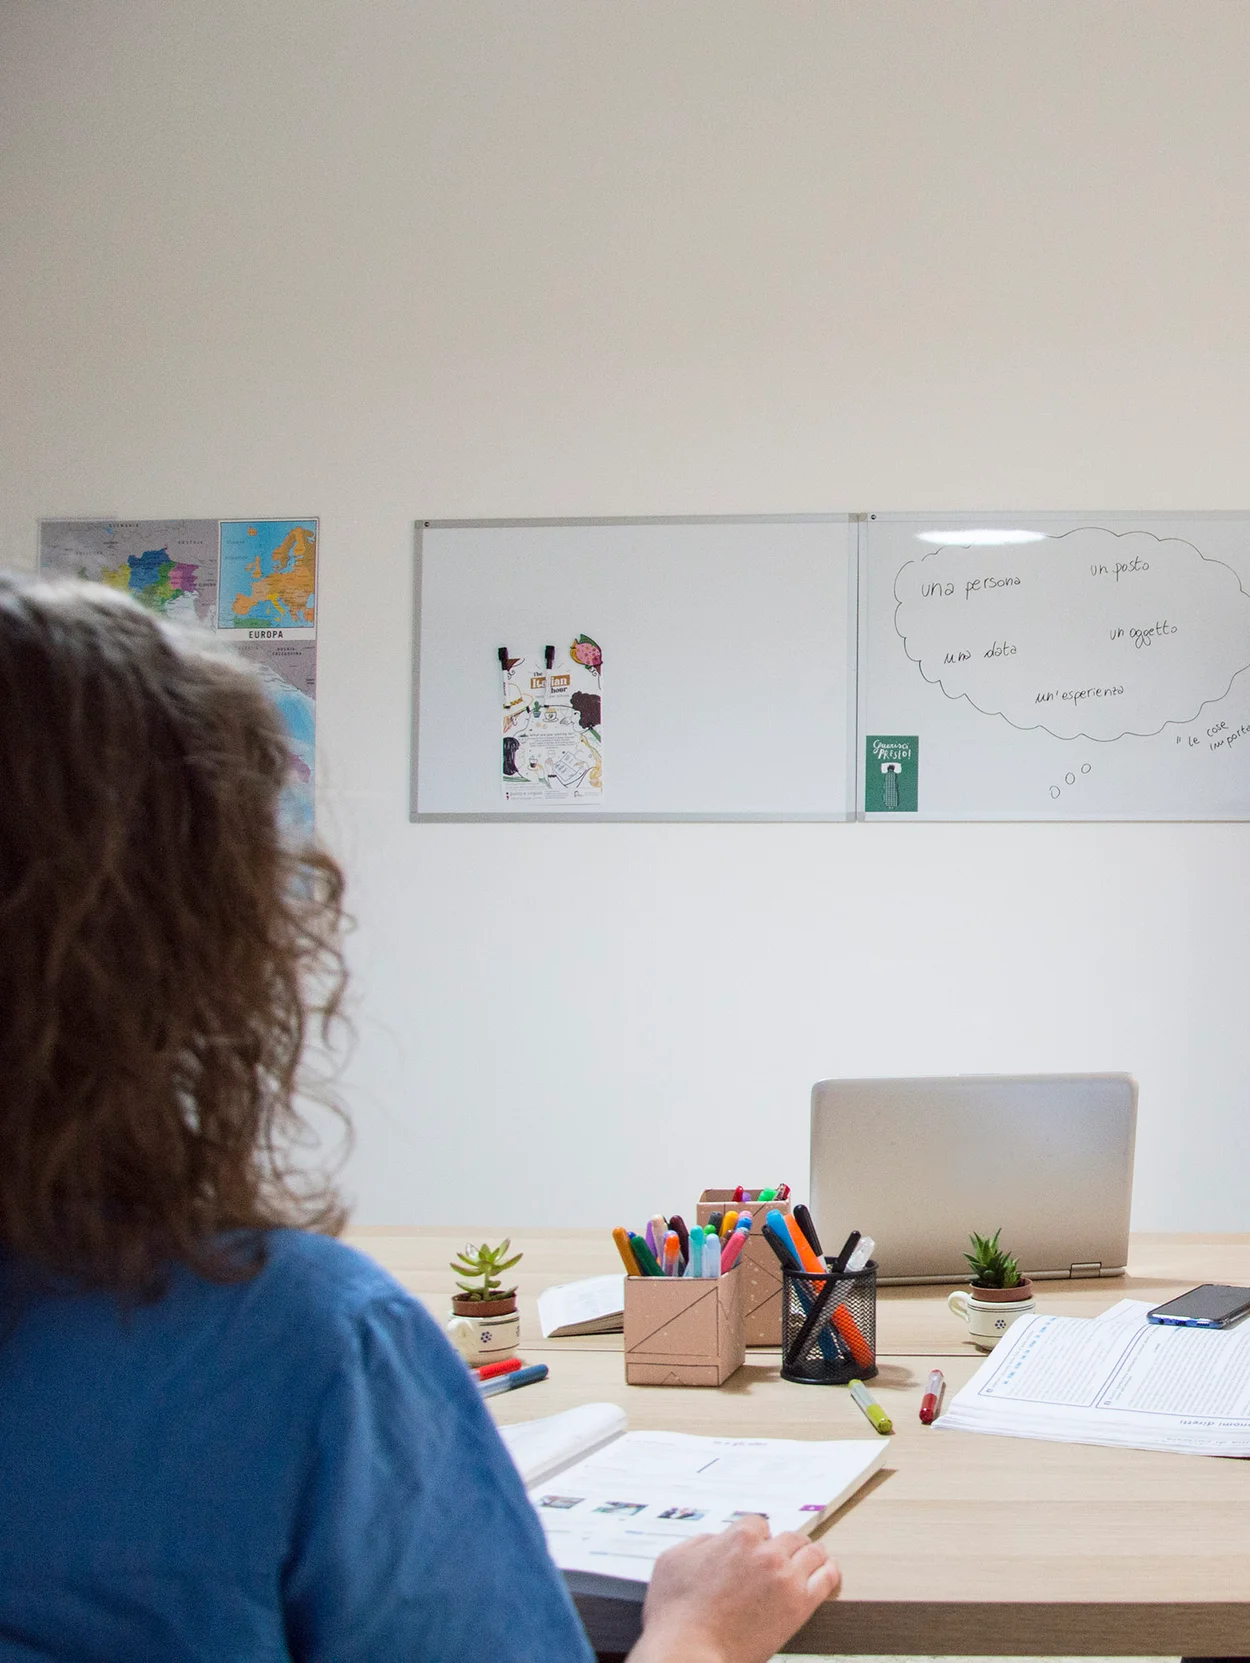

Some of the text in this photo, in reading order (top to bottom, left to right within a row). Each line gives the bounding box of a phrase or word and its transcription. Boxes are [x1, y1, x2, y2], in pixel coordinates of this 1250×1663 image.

[1091, 556, 1150, 582] un posto
[921, 577, 1021, 600] una persona
[248, 630, 284, 639] EUROPA
[1110, 620, 1178, 649] un oggetto
[983, 641, 1017, 658] data
[550, 686, 568, 694] hour
[1206, 721, 1229, 737] cose
[878, 748, 912, 760] PRESTO!
[1179, 1419, 1215, 1427] diretti
